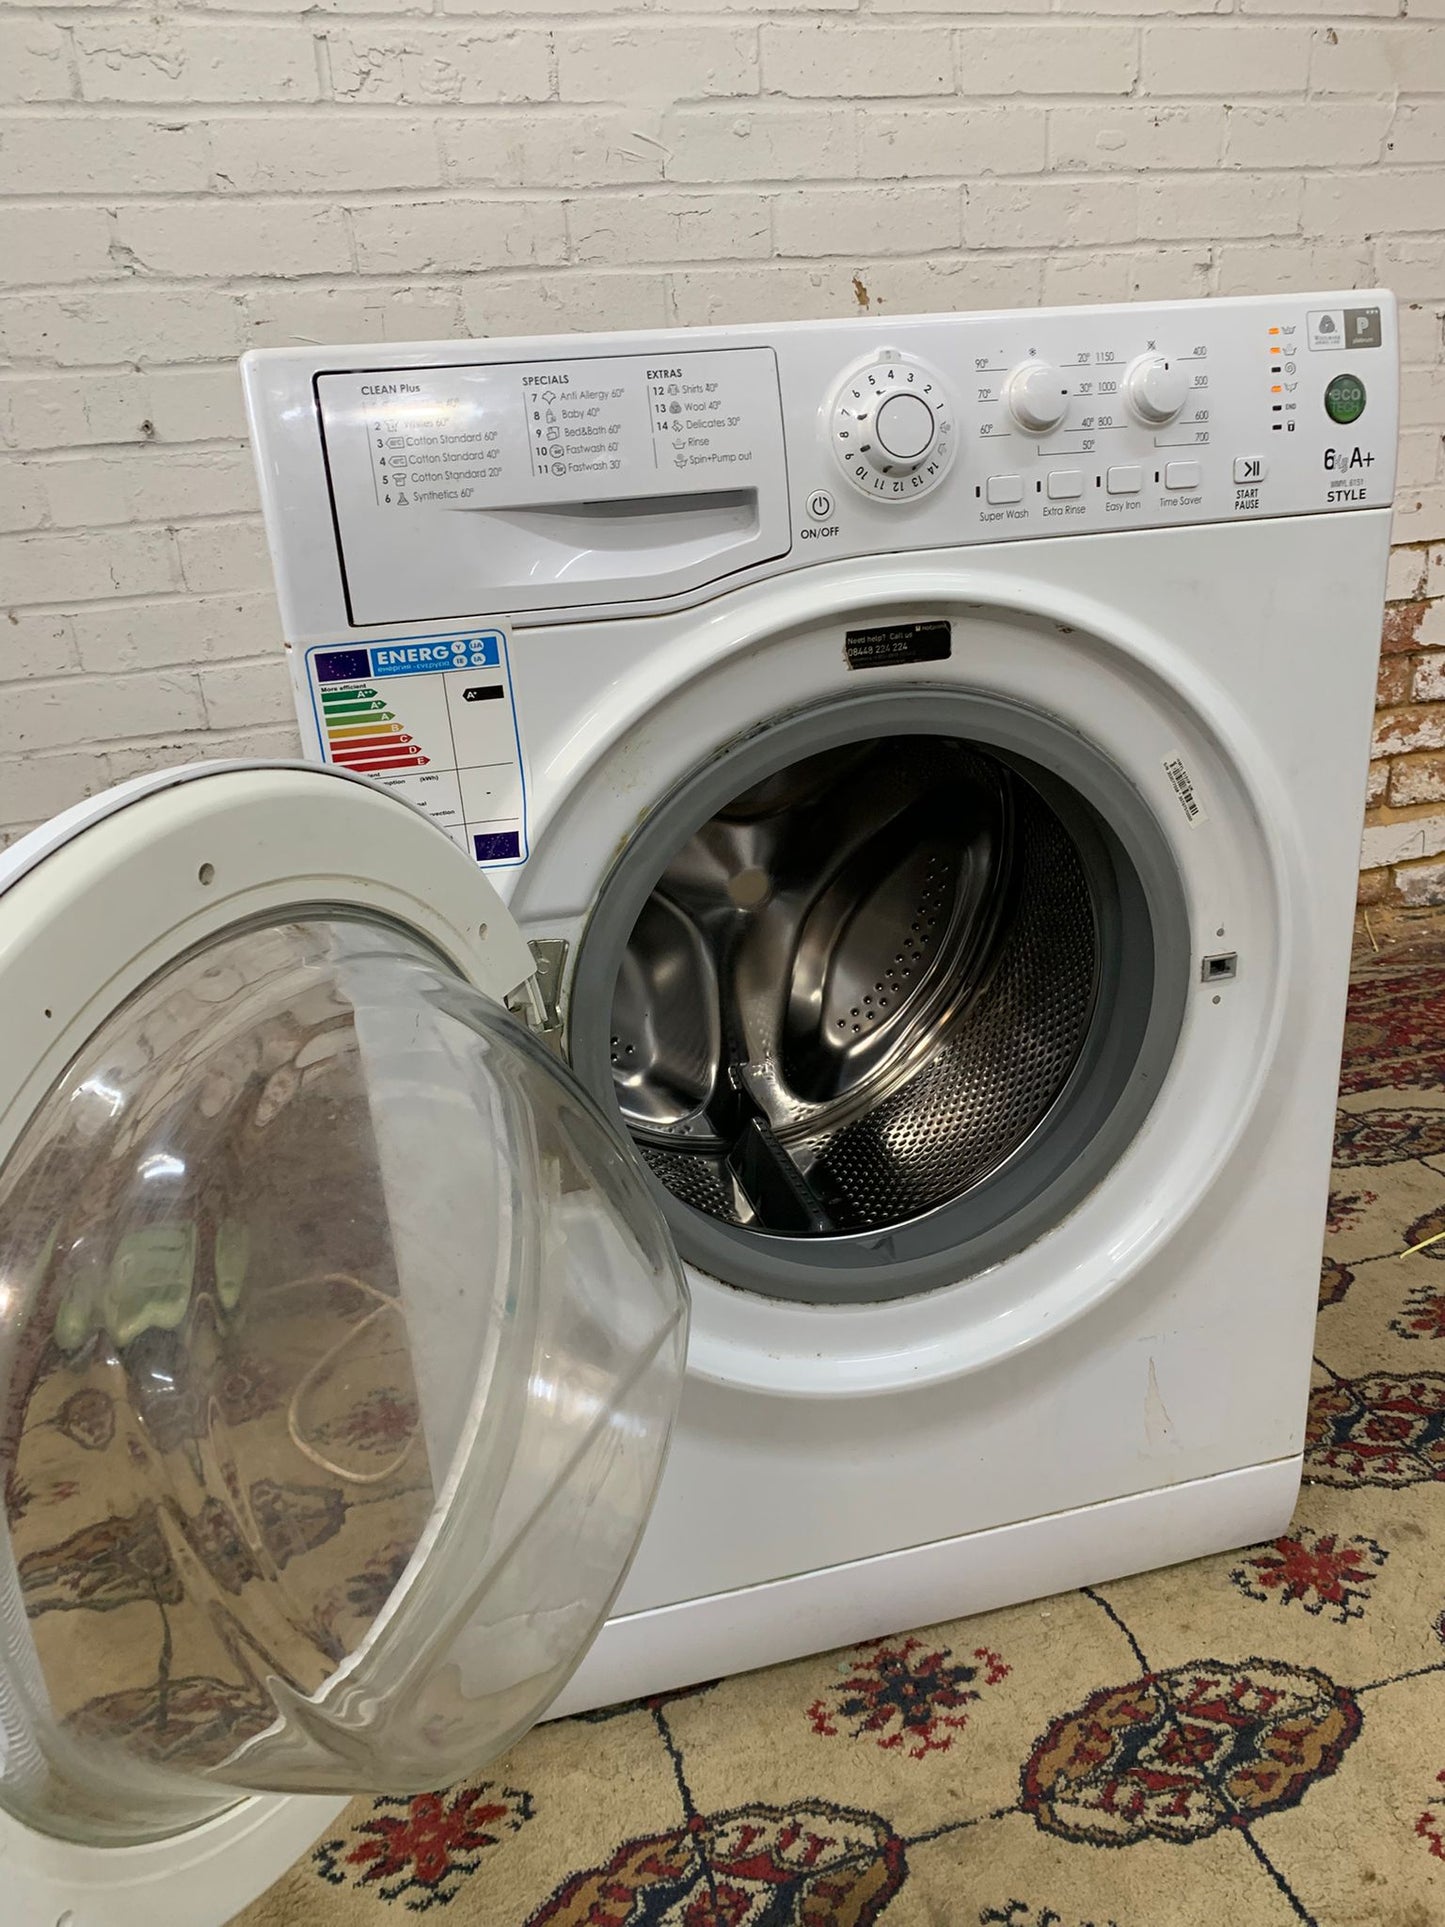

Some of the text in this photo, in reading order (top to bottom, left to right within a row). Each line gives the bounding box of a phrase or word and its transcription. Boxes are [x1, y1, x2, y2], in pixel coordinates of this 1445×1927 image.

[1357, 317, 1368, 334] P
[1096, 352, 1114, 361] 1150
[1193, 346, 1206, 356] 400
[647, 369, 682, 379] EXTRAS
[888, 370, 894, 379] 4
[907, 373, 914, 382] 3
[522, 375, 569, 385] SPECIALS
[868, 375, 875, 385] 5
[1195, 376, 1208, 385] 500
[361, 384, 420, 395] CLEAN Plus
[653, 387, 664, 395] 12
[683, 384, 703, 394] Shirts
[923, 385, 932, 394] 2
[1098, 382, 1116, 391] 1000
[532, 393, 537, 402] 7
[560, 392, 577, 401] Anti
[580, 390, 609, 401] Allergy
[1332, 388, 1361, 401] eco
[656, 404, 666, 413] 13
[685, 402, 706, 412] Wool
[534, 411, 540, 420] 8
[562, 409, 585, 420] Baby
[1195, 411, 1208, 420] 600
[374, 422, 381, 430] 2
[657, 422, 668, 431] 14
[686, 419, 725, 429] Delicates
[1098, 417, 1112, 426] 800
[536, 429, 542, 438] 9
[564, 426, 607, 437] Bed&Bath
[1195, 432, 1209, 441] 700
[377, 439, 383, 448] 3
[406, 436, 437, 447] Cotton
[440, 433, 482, 445] Standard
[688, 437, 709, 447] Rinse
[536, 447, 547, 456] 10
[566, 443, 606, 454] Fastwash
[380, 457, 386, 466] 4
[409, 454, 440, 464] Cotton
[442, 450, 484, 462] Standard
[689, 452, 752, 466] Spin+Pump out
[1350, 447, 1375, 468] A+
[538, 465, 548, 474] 11
[568, 461, 608, 472] Fastwash
[928, 462, 938, 474] 14
[382, 476, 388, 484] 5
[411, 472, 442, 482] Cotton
[445, 468, 486, 480] Standard
[856, 467, 868, 480] 10
[874, 478, 885, 490] 11
[893, 482, 904, 491] 12
[912, 475, 923, 487] 13
[385, 495, 391, 503] 6
[413, 490, 459, 502] Synthetics
[1237, 489, 1258, 499] START
[1327, 489, 1366, 502] STYLE
[1106, 501, 1141, 512] Easy Iron
[1160, 496, 1202, 506] Time Saver
[1235, 499, 1259, 510] PAUSE
[980, 509, 1029, 522] Super Wash
[1043, 505, 1086, 516] Extra Rinse
[801, 527, 839, 539] ON/OFF
[867, 634, 886, 643] help?
[890, 632, 903, 640] Call
[377, 646, 449, 665] ENERG
[340, 683, 367, 691] efficient
